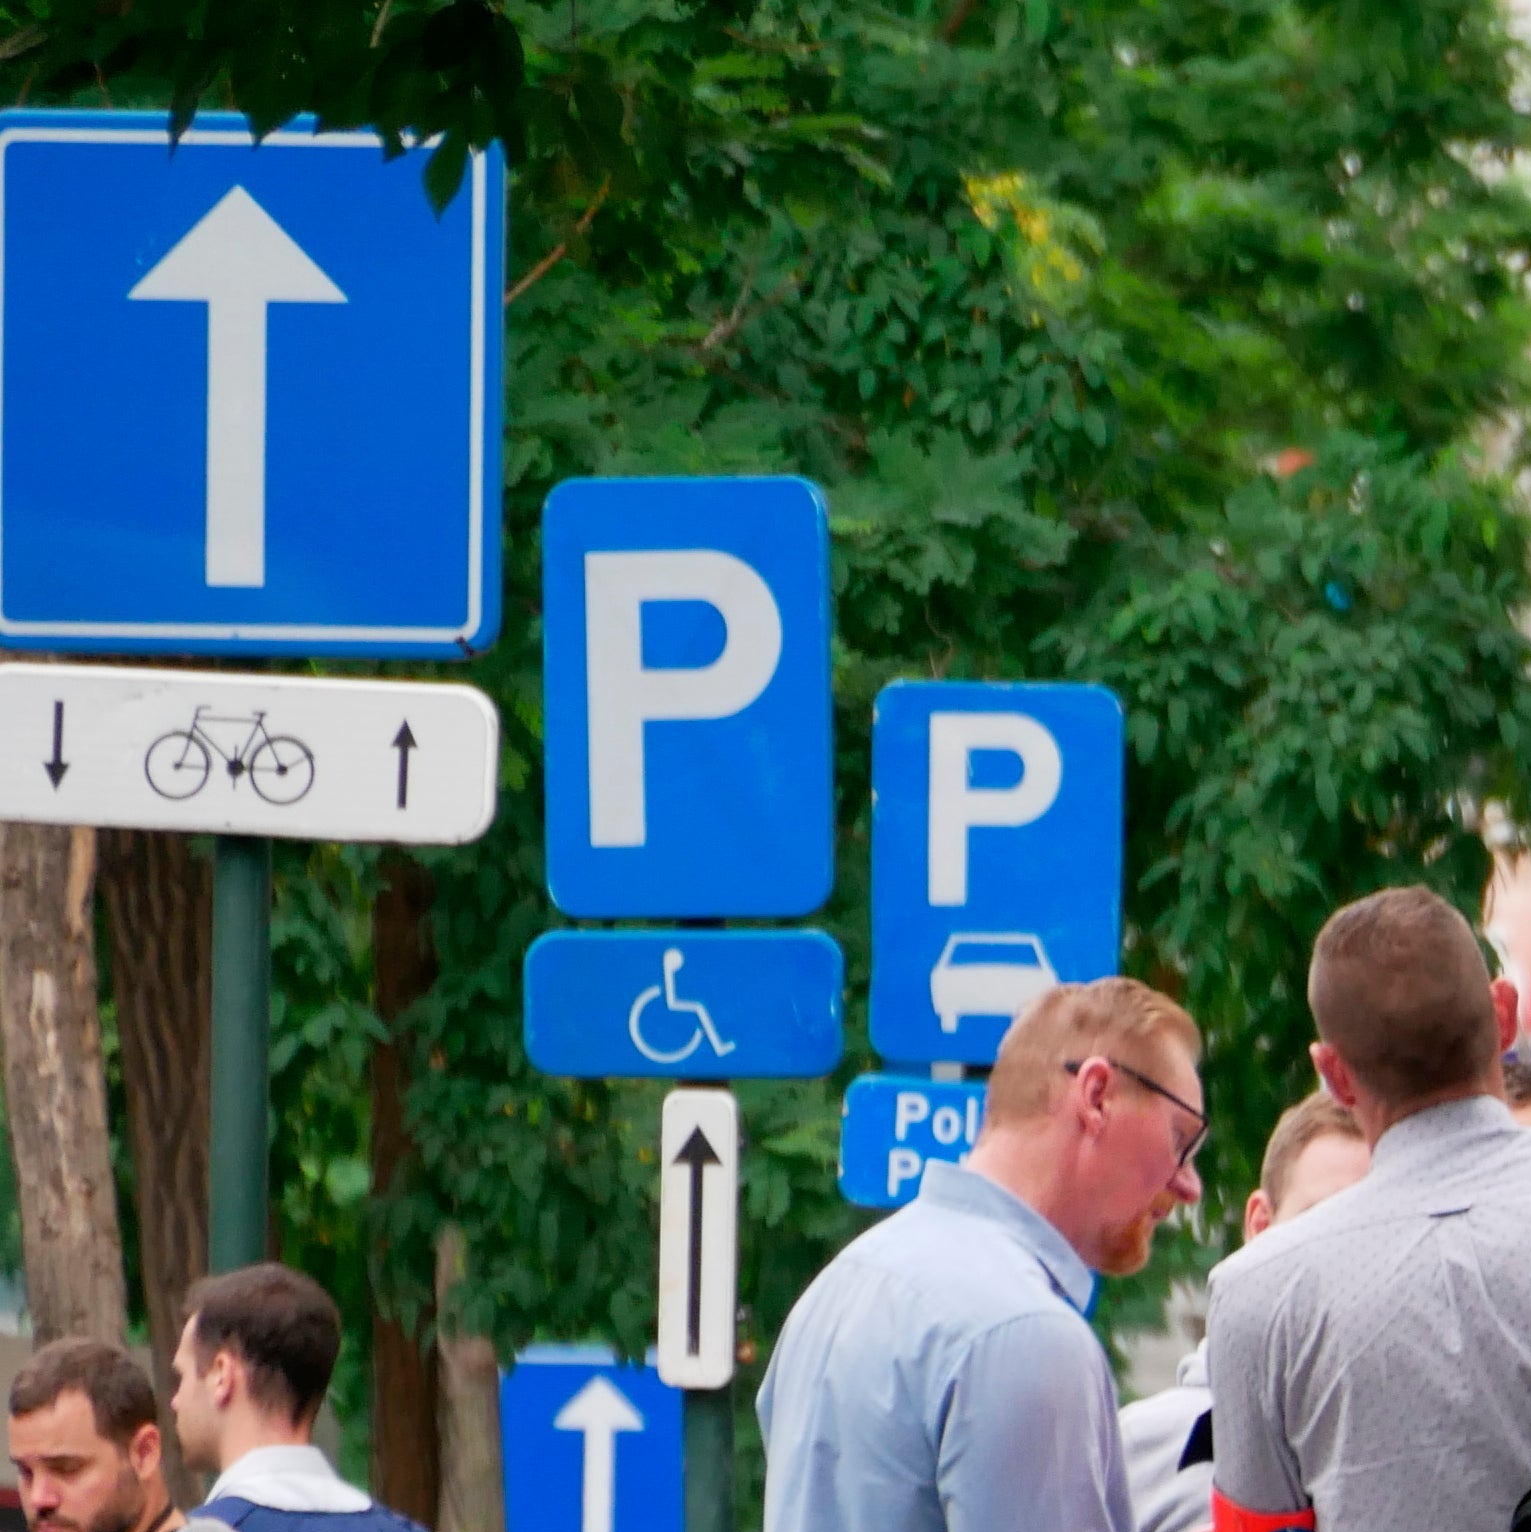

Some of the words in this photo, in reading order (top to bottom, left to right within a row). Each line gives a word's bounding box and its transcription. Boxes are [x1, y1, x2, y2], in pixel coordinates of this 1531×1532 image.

[586, 550, 782, 848] P
[928, 712, 1062, 907] P
[895, 1091, 978, 1145] Pol
